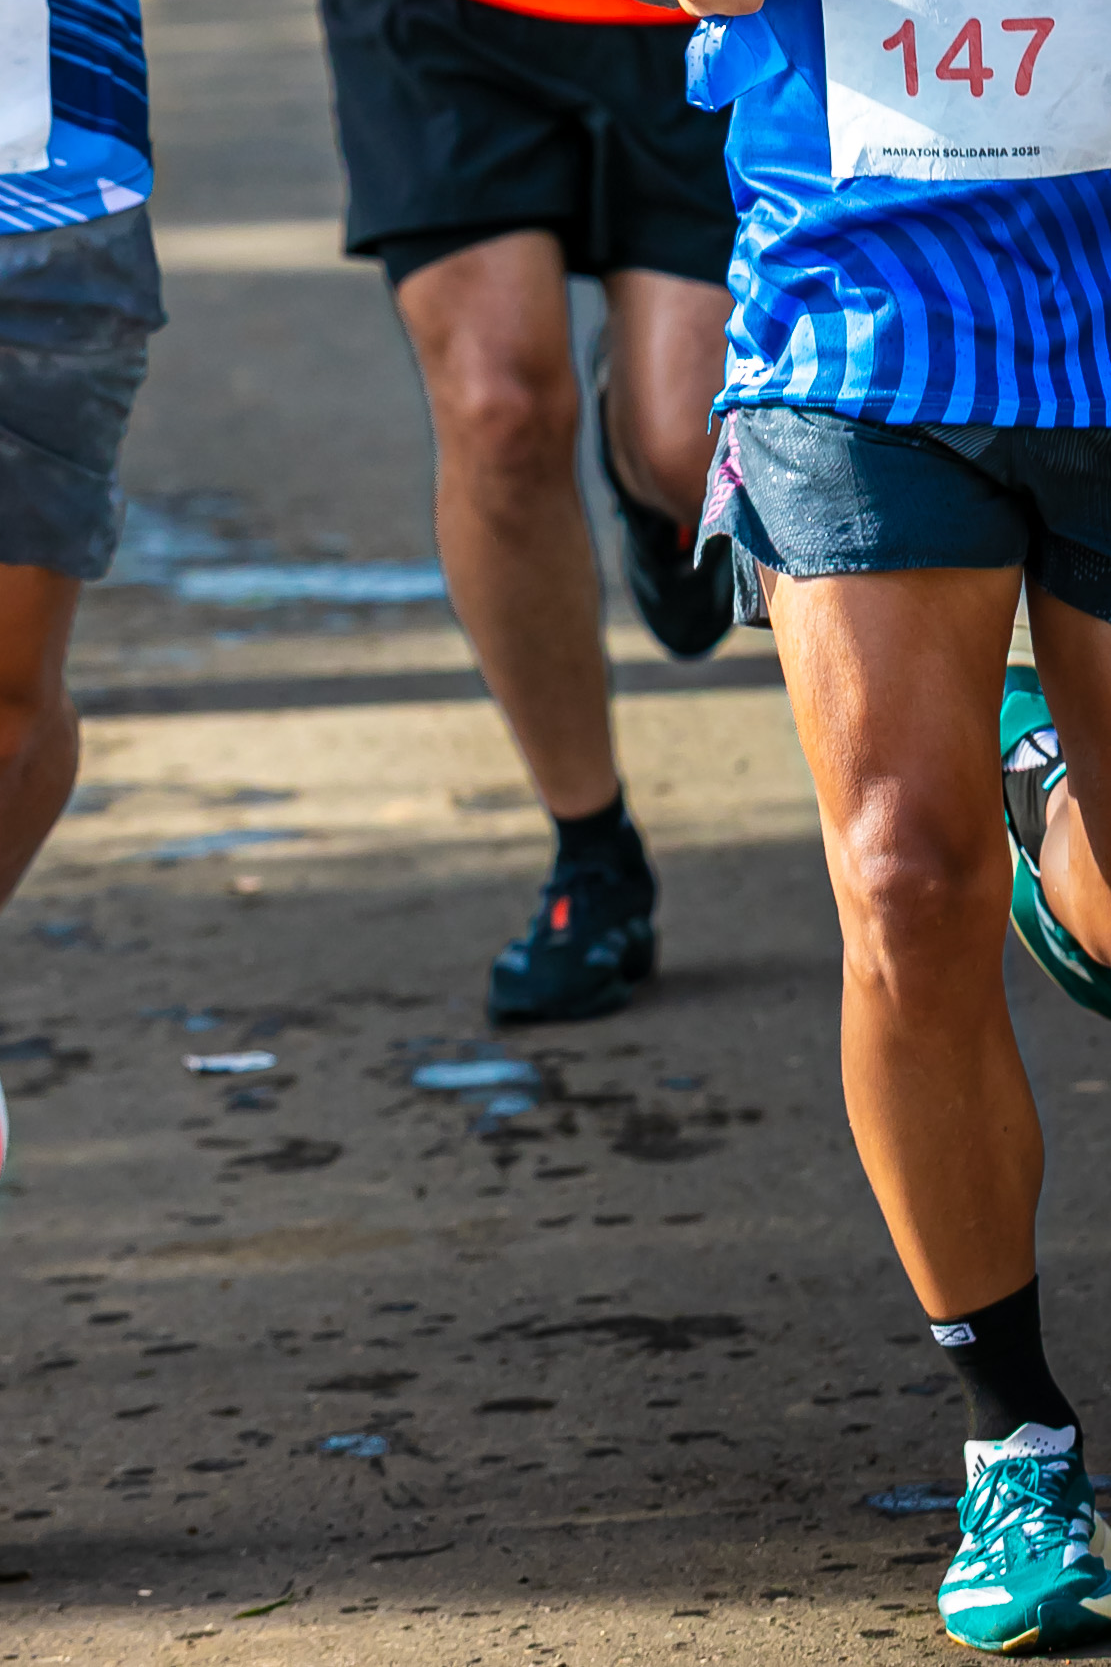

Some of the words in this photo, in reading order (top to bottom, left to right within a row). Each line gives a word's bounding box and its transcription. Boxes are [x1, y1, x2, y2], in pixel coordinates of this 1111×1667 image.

[883, 18, 1055, 98] 147
[882, 147, 940, 158] MARATON
[942, 147, 1008, 158] SOLIDARIA
